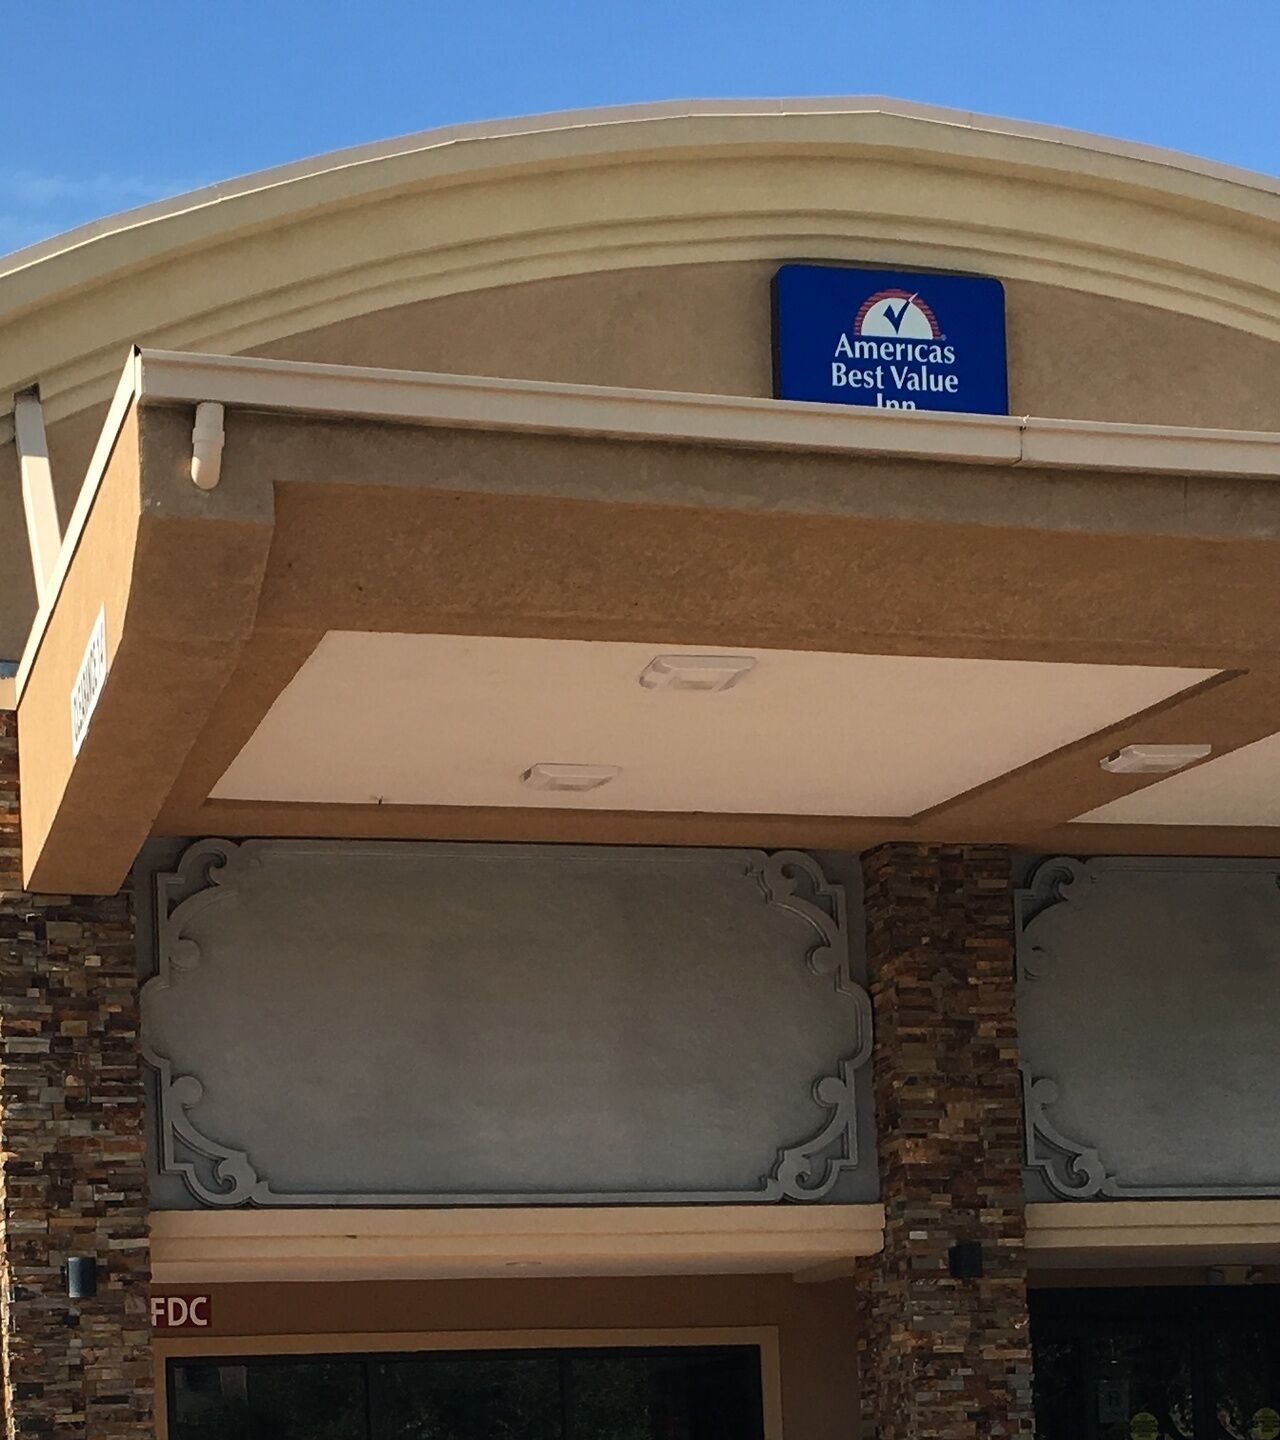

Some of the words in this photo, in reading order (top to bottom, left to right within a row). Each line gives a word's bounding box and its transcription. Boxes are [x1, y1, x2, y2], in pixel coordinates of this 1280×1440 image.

[834, 332, 956, 364] Americas
[831, 362, 885, 389] Best
[889, 365, 959, 393] Value
[150, 1296, 208, 1327] FDC
